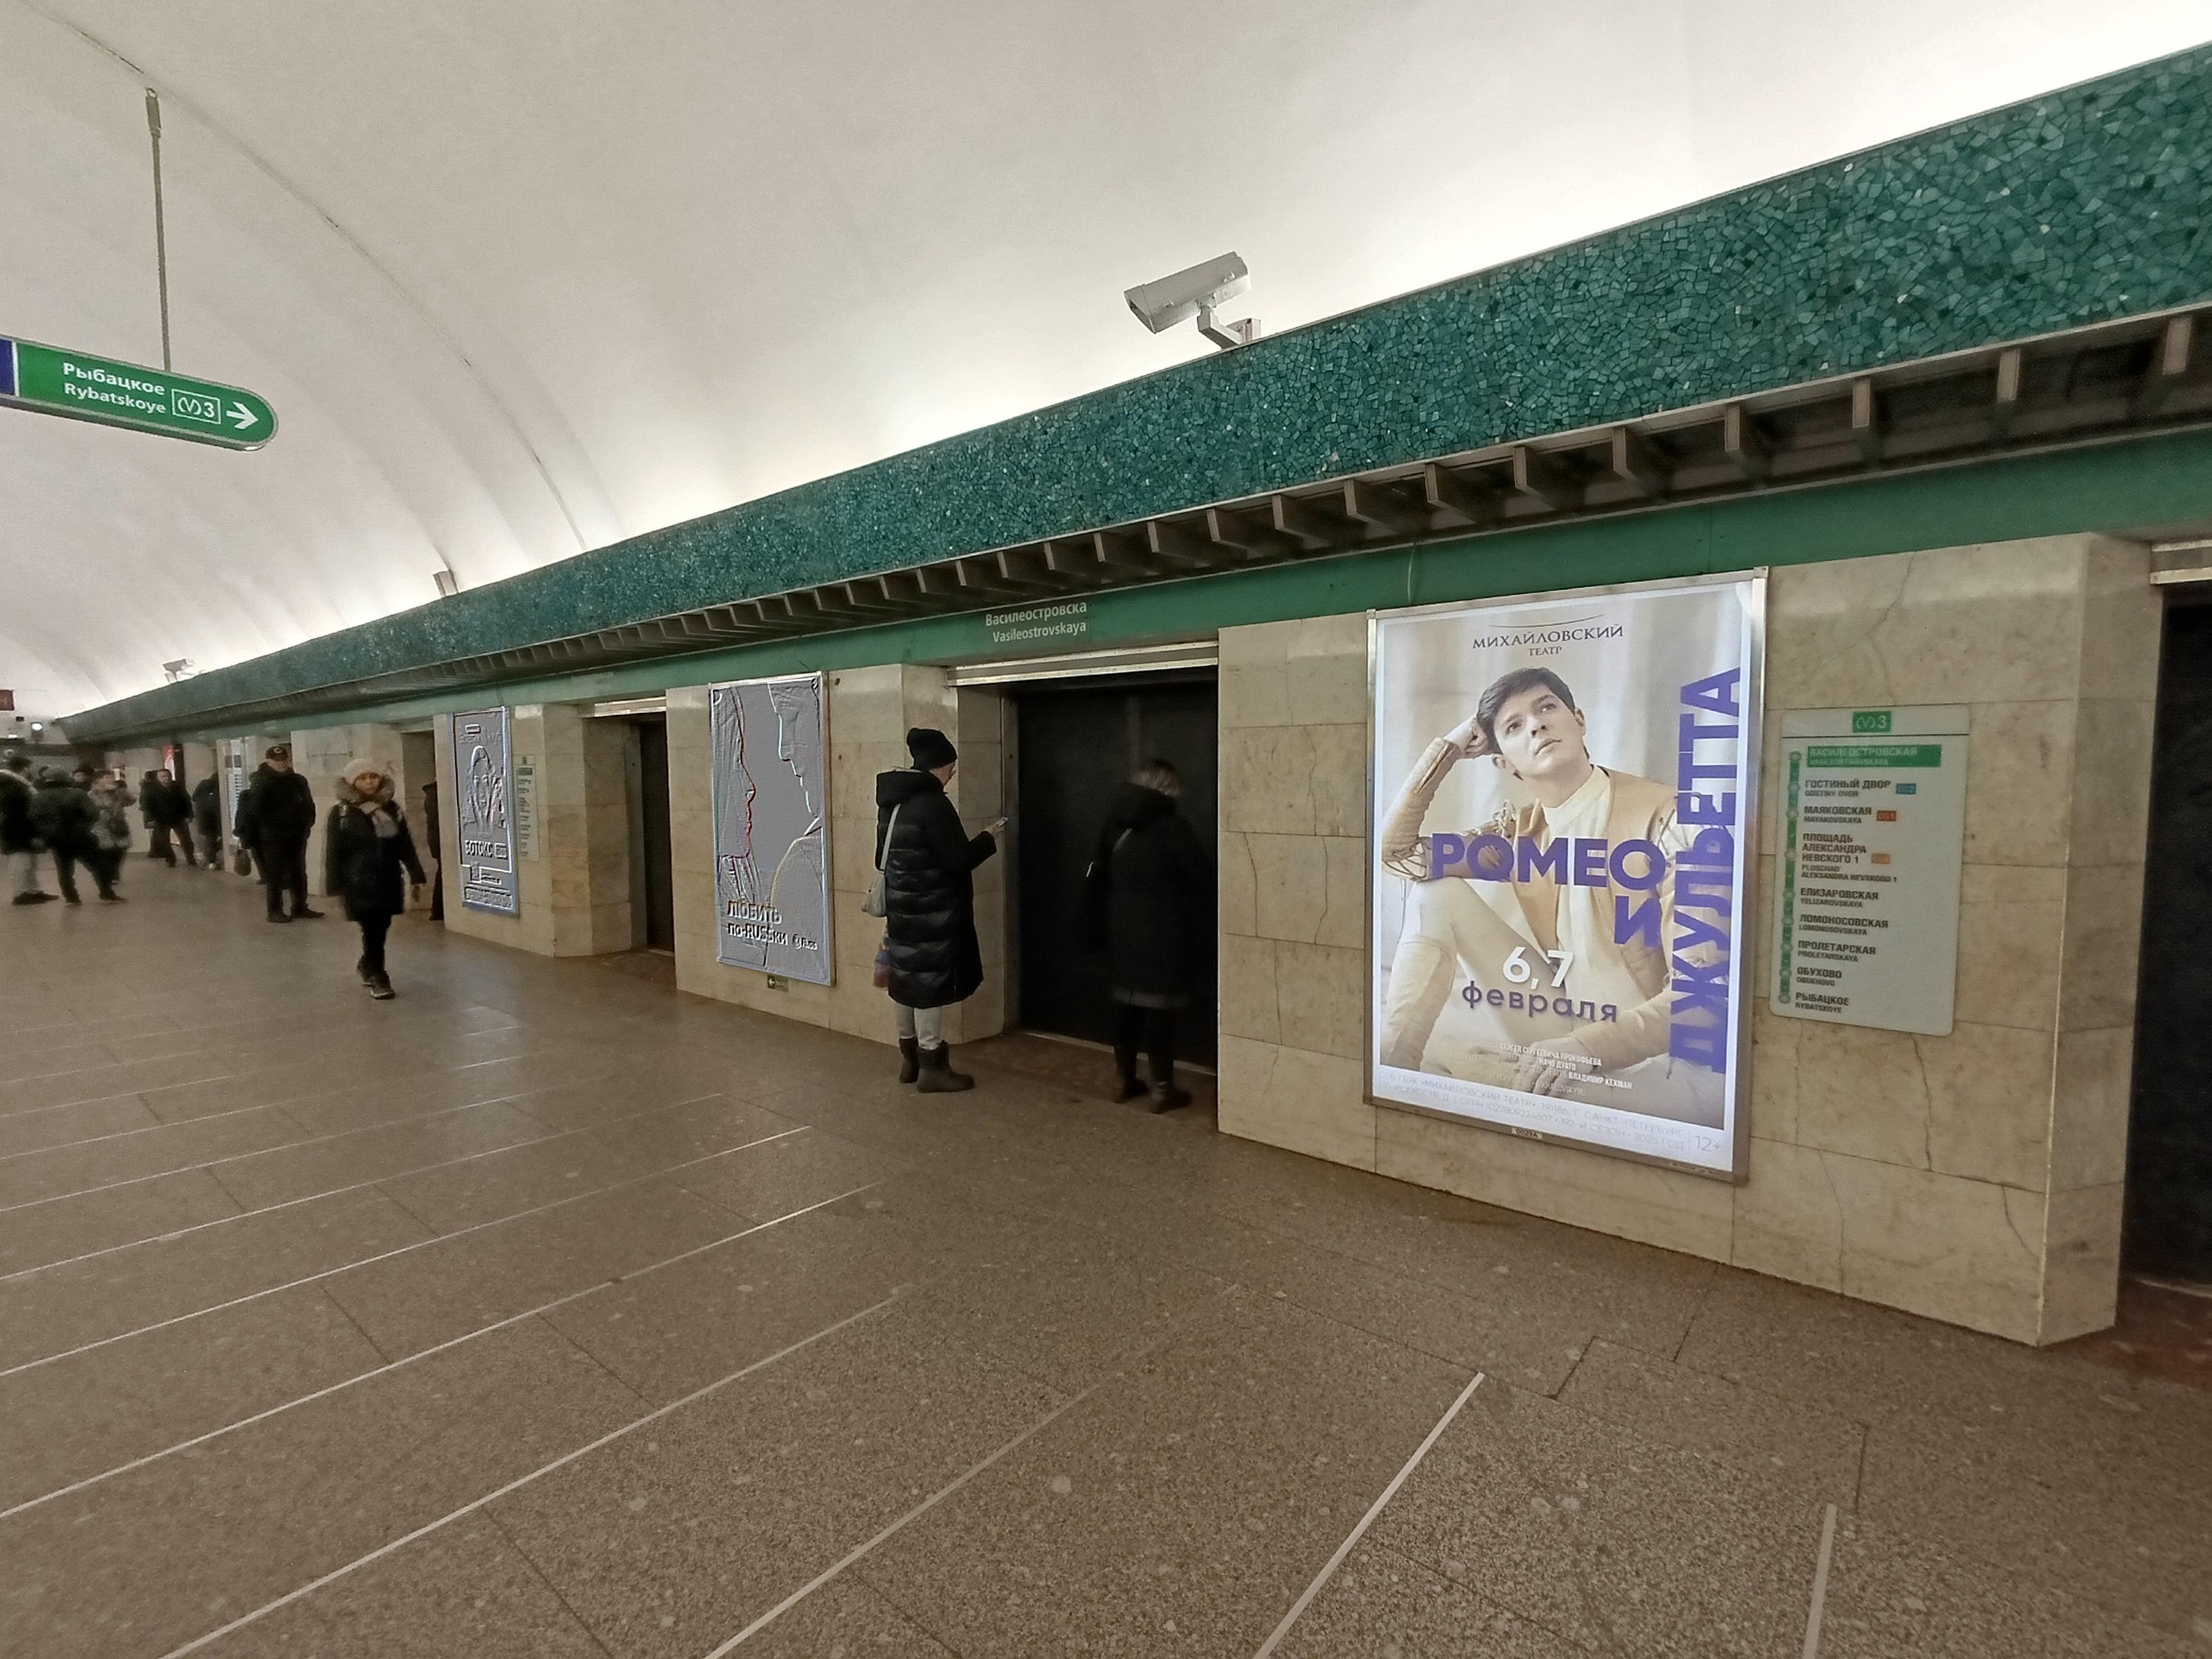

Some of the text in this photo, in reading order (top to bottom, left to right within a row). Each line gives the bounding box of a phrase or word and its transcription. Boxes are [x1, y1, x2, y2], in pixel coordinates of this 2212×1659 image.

[62, 362, 165, 395] Рыбацкое
[64, 383, 166, 414] Rybatskoye
[985, 602, 1086, 626] Василеостровска
[993, 621, 1086, 642] Vasileostrovskaya
[1473, 624, 1623, 649] МИХАЙЛОВСКИЙ
[1529, 646, 1562, 656] ТЕАТР
[1809, 747, 1917, 756] ВАСИЛЕОСТРОВСКАЯ
[1805, 778, 1860, 788] ГОСТИНЫЙ
[1862, 780, 1891, 790] ДВОР
[1804, 806, 1872, 815] МАЯКОВСКАЯ
[1803, 833, 1853, 843] ПЛОЩАДЬ
[1802, 843, 1866, 854] АЛЕКСАНДРА
[1432, 833, 1666, 890] РОМЕО
[1802, 853, 1851, 863] НЕВСКОГО
[1670, 667, 1741, 1073] ДЖУЛЬЕТТА
[1801, 888, 1879, 900] ЕЛИЗАРОВСКАЯ
[727, 900, 782, 924] ЛЮБИТЬ
[1614, 895, 1660, 947] И
[1799, 914, 1889, 928] ЛОМОНОСОВСКАЯ
[1798, 940, 1876, 954] ПРОЛЕТАРСКАЯ
[1797, 951, 1858, 962] PROLETARSKAYA
[1797, 967, 1842, 979] ОБУХОВО
[1462, 981, 1617, 1023] февраля
[1795, 992, 1849, 1006] РЫБАЦКОЕ
[1557, 1061, 1576, 1071] ДУАТО
[1568, 1071, 1604, 1084] ВЛАДИМИР
[1696, 1135, 1721, 1151] 12+
